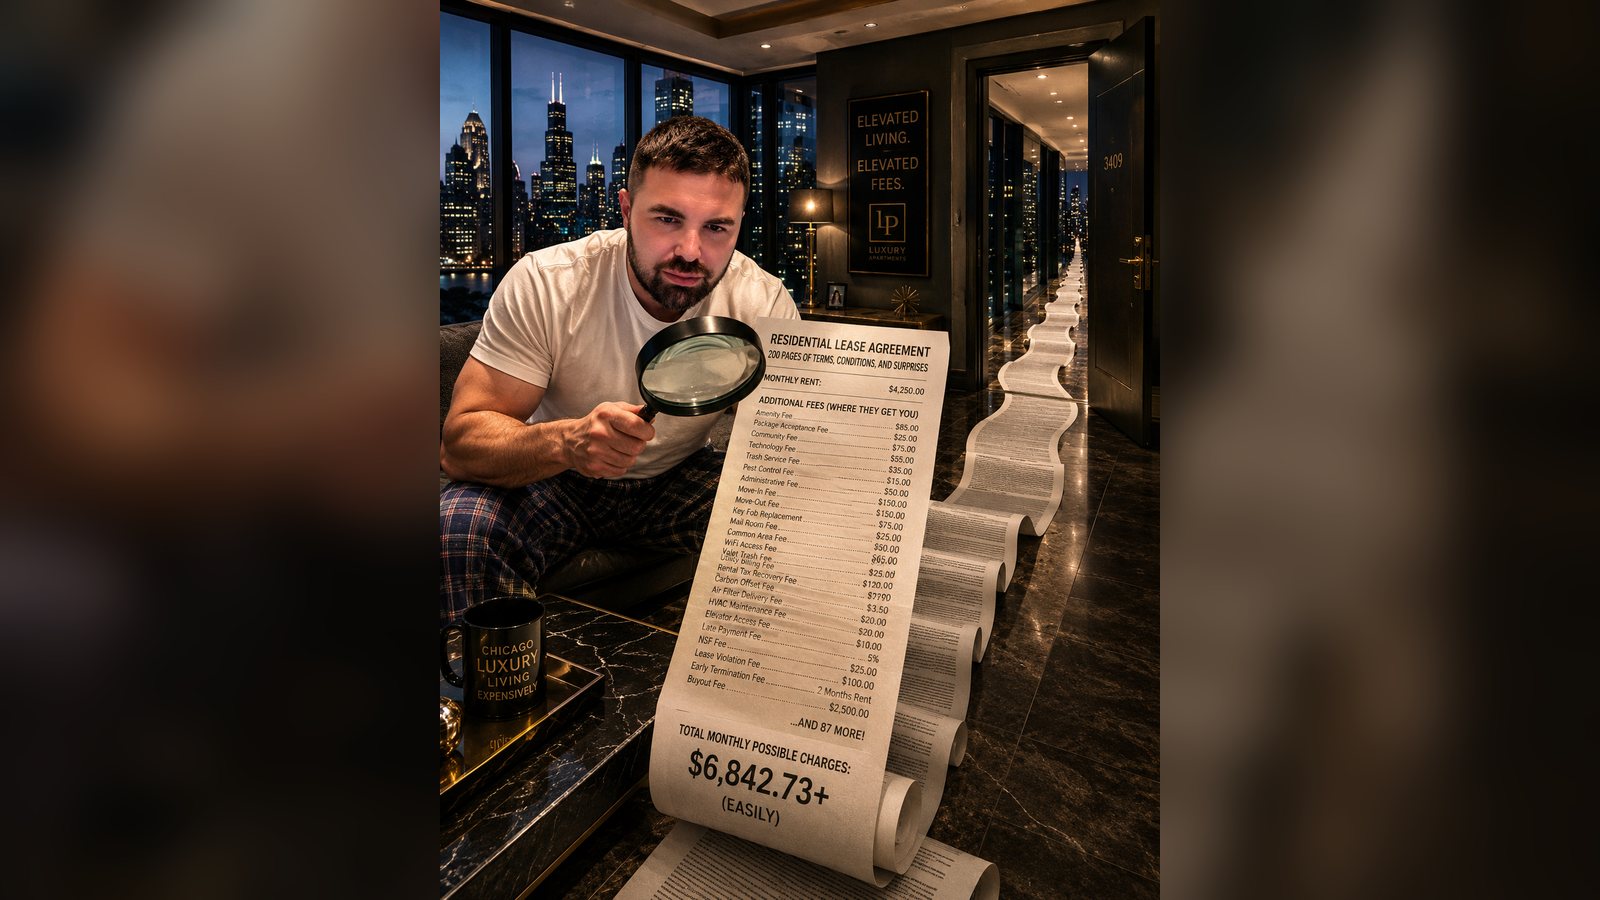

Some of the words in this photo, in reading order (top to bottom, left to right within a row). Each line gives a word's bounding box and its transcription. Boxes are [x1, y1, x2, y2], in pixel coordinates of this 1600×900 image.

[857, 110, 919, 128] ELEVATED
[865, 131, 910, 147] LIVING.
[857, 156, 919, 172] ELEVATED
[1103, 153, 1123, 171] 3409
[871, 177, 905, 191] FEES.
[869, 246, 906, 255] LUXURY
[770, 333, 832, 350] RESIDENTIAL
[834, 339, 866, 353] LEASE
[868, 342, 931, 358] AGREEMENT
[768, 350, 780, 359] 200
[780, 351, 802, 361] PAGES
[802, 353, 812, 362] OF
[813, 354, 835, 365] TERMS,
[836, 356, 877, 369] CONDITIONS,
[877, 360, 893, 369] AND
[893, 362, 929, 372] SURPRISES
[763, 374, 799, 384] MONTHLY
[800, 377, 822, 387] RENT:
[888, 385, 925, 396] $4,250.00
[758, 396, 804, 408] ADDITIONAL
[806, 400, 825, 410] FEES
[826, 402, 857, 414] (WHERE
[858, 405, 879, 415] THEY
[881, 407, 897, 417] GET
[898, 409, 919, 419] YOU)
[753, 419, 781, 430] Package
[782, 422, 816, 433] Acceptance
[816, 426, 829, 434] Fee
[893, 433, 918, 443] $25.00
[755, 409, 780, 419] Amenity
[895, 423, 919, 432] $85.00
[748, 441, 783, 453] Technology
[784, 445, 796, 453] Fee
[890, 455, 914, 465] $55.00
[751, 430, 785, 441] Community
[786, 434, 798, 442] Fee
[892, 444, 916, 454] $75.00
[743, 463, 757, 472] Pest
[758, 465, 781, 475] Control
[782, 468, 795, 476] Fee
[886, 477, 911, 487] $15.00
[746, 452, 763, 461] Trash
[764, 454, 787, 463] Service
[788, 457, 800, 465] Fee
[888, 466, 913, 476] $35.00
[738, 485, 762, 496] Move-In
[764, 489, 777, 497] Fee
[878, 498, 907, 509] $150.00
[740, 474, 785, 486] Administrative
[786, 480, 799, 488] Fee
[884, 487, 909, 498] $50.00
[733, 507, 744, 517] Key
[745, 508, 758, 517] Fob
[759, 510, 802, 522] Replacement
[878, 521, 904, 531] $75.00
[735, 496, 766, 507] Move-Out
[768, 500, 780, 509] Fee
[876, 509, 906, 520] $150.00
[727, 528, 756, 538] Common
[757, 533, 773, 541] Area
[775, 534, 787, 543] Fee
[874, 543, 900, 554] $50.00
[729, 518, 744, 526] Mail
[745, 520, 764, 529] Room
[765, 522, 778, 531] Fee
[875, 532, 902, 542] $25.00
[722, 547, 739, 557] Valet
[740, 550, 758, 560] Trash
[760, 553, 772, 562] Fee
[724, 539, 738, 547] WiFi
[739, 541, 763, 551] Access
[765, 544, 777, 553] Fee
[717, 564, 738, 574] Rental
[740, 567, 752, 576] Tax
[753, 569, 784, 583] Recovery
[784, 576, 797, 585] Fee
[762, 561, 775, 570] Fee
[862, 580, 893, 590] $120.00
[711, 586, 722, 594] Air
[723, 588, 741, 598] Filter
[742, 591, 768, 604] Delivery
[770, 596, 783, 605] Fee
[860, 615, 887, 627] $20.00
[714, 574, 739, 585] Carbon
[740, 578, 761, 589] Offset
[762, 583, 775, 591] Fee
[866, 604, 889, 615] $3.50
[705, 610, 732, 622] Elevator
[733, 614, 757, 627] Access
[758, 621, 771, 629] Fee
[856, 639, 882, 651] $10.00
[709, 598, 728, 608] HVAC
[729, 601, 772, 616] Maintenance
[774, 610, 787, 619] Fee
[858, 628, 885, 639] $20.00
[481, 639, 534, 655] CHICAGO
[702, 622, 717, 632] Late
[717, 625, 748, 639] Payment
[749, 632, 761, 641] Fee
[867, 654, 880, 663] 5%
[476, 649, 538, 673] LUXURY
[698, 635, 713, 644] NSF
[714, 639, 727, 648] Fee
[850, 664, 877, 677] $25.00
[488, 671, 530, 688] LIVING
[694, 649, 715, 660] Lease
[716, 653, 746, 666] Violation
[748, 659, 760, 669] Fee
[842, 676, 875, 690] $100.00
[477, 681, 538, 701] EXPENSIVELY
[691, 661, 709, 673] Early
[710, 665, 750, 681] Termination
[752, 675, 766, 684] Fee
[817, 686, 823, 695] 2
[823, 687, 852, 702] Months
[853, 693, 872, 705] Rent
[687, 675, 712, 688] Buyout
[713, 681, 726, 690] Fee
[829, 702, 870, 719] $2,500.00
[789, 718, 819, 730] ...AND
[819, 722, 832, 733] 87
[834, 724, 865, 741] MORE!
[679, 724, 705, 740] TOTAL
[707, 730, 751, 751] MONTHLY
[751, 740, 798, 761] POSSIBLE
[800, 752, 851, 775] CHARGES:
[688, 748, 830, 806] $6,842.73+
[722, 795, 780, 828] (EASILY)
